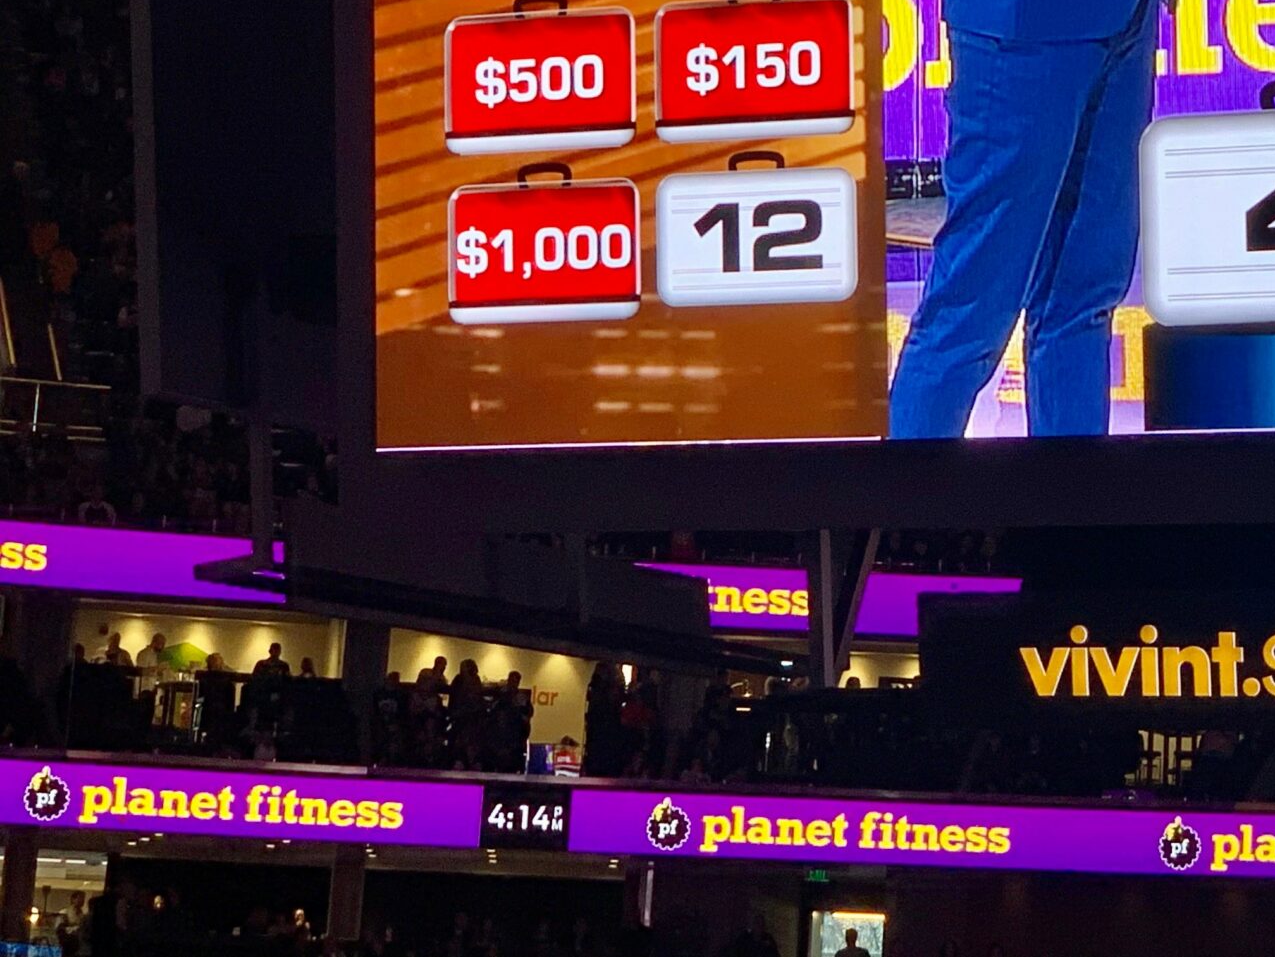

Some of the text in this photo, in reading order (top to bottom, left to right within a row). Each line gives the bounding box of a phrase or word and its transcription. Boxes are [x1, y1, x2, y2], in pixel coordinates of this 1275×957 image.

[474, 54, 605, 109] $500
[685, 40, 822, 95] $150
[456, 223, 632, 281] $1,000
[692, 199, 824, 275] 12
[79, 777, 235, 824] planet
[245, 785, 403, 829] fitness
[488, 803, 550, 831] 4:14
[699, 806, 849, 852] planet
[858, 811, 1011, 854] fitness
